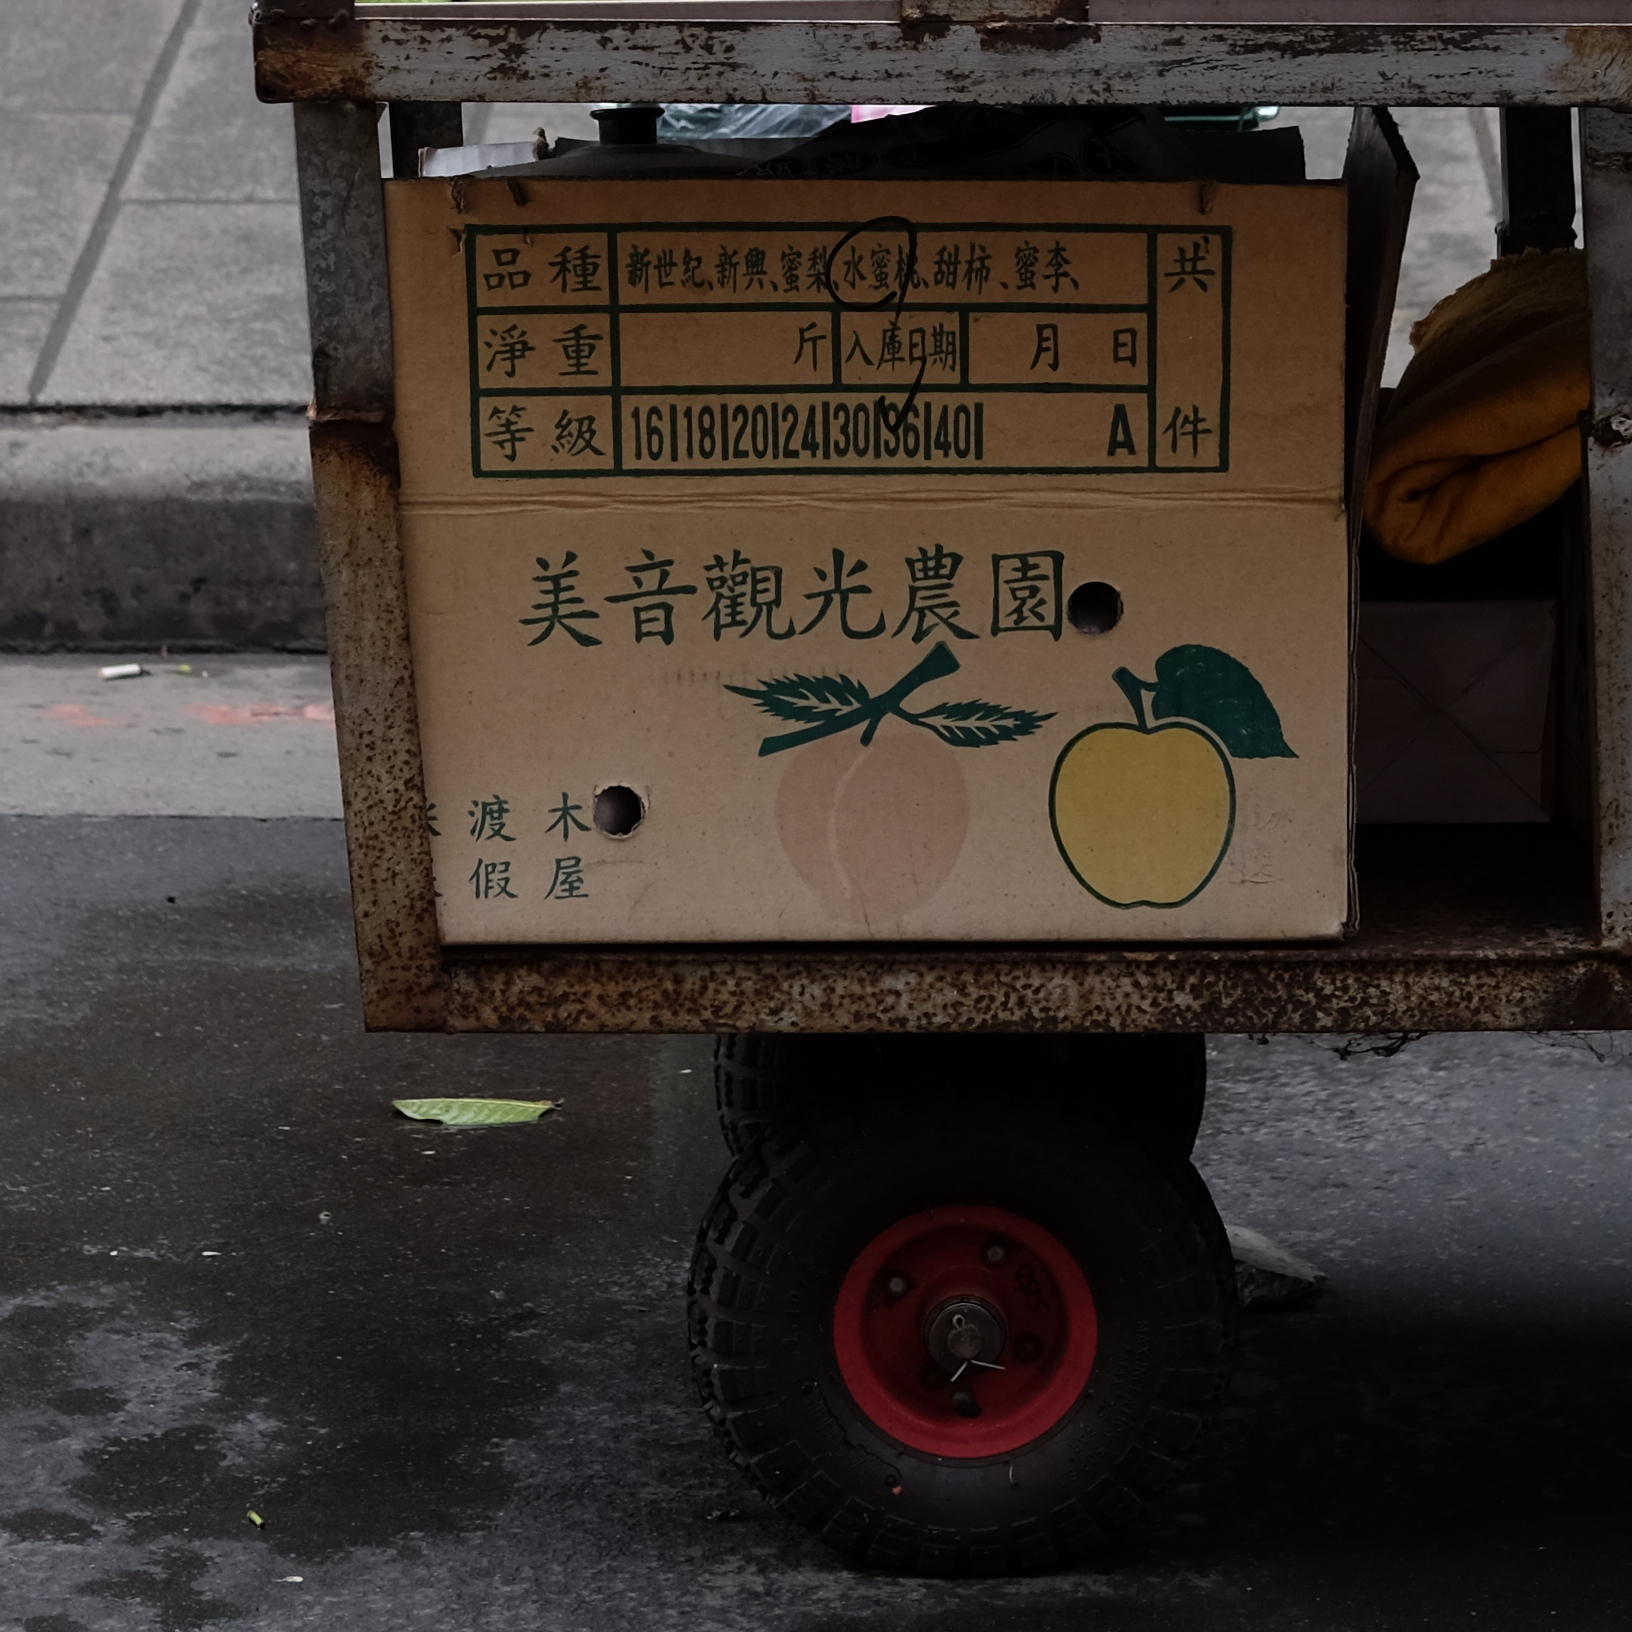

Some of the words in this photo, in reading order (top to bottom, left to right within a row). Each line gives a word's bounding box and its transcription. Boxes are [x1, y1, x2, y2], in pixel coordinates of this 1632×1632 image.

[483, 245, 603, 294] 品種
[1163, 241, 1216, 294] 共
[484, 324, 604, 378] 淨重
[793, 322, 827, 372] 斤
[845, 327, 958, 373] 入庫日期
[483, 404, 607, 463] 等級
[1107, 404, 1136, 456] A
[1162, 404, 1214, 458] 件
[519, 544, 1066, 647] 美音觀光農園
